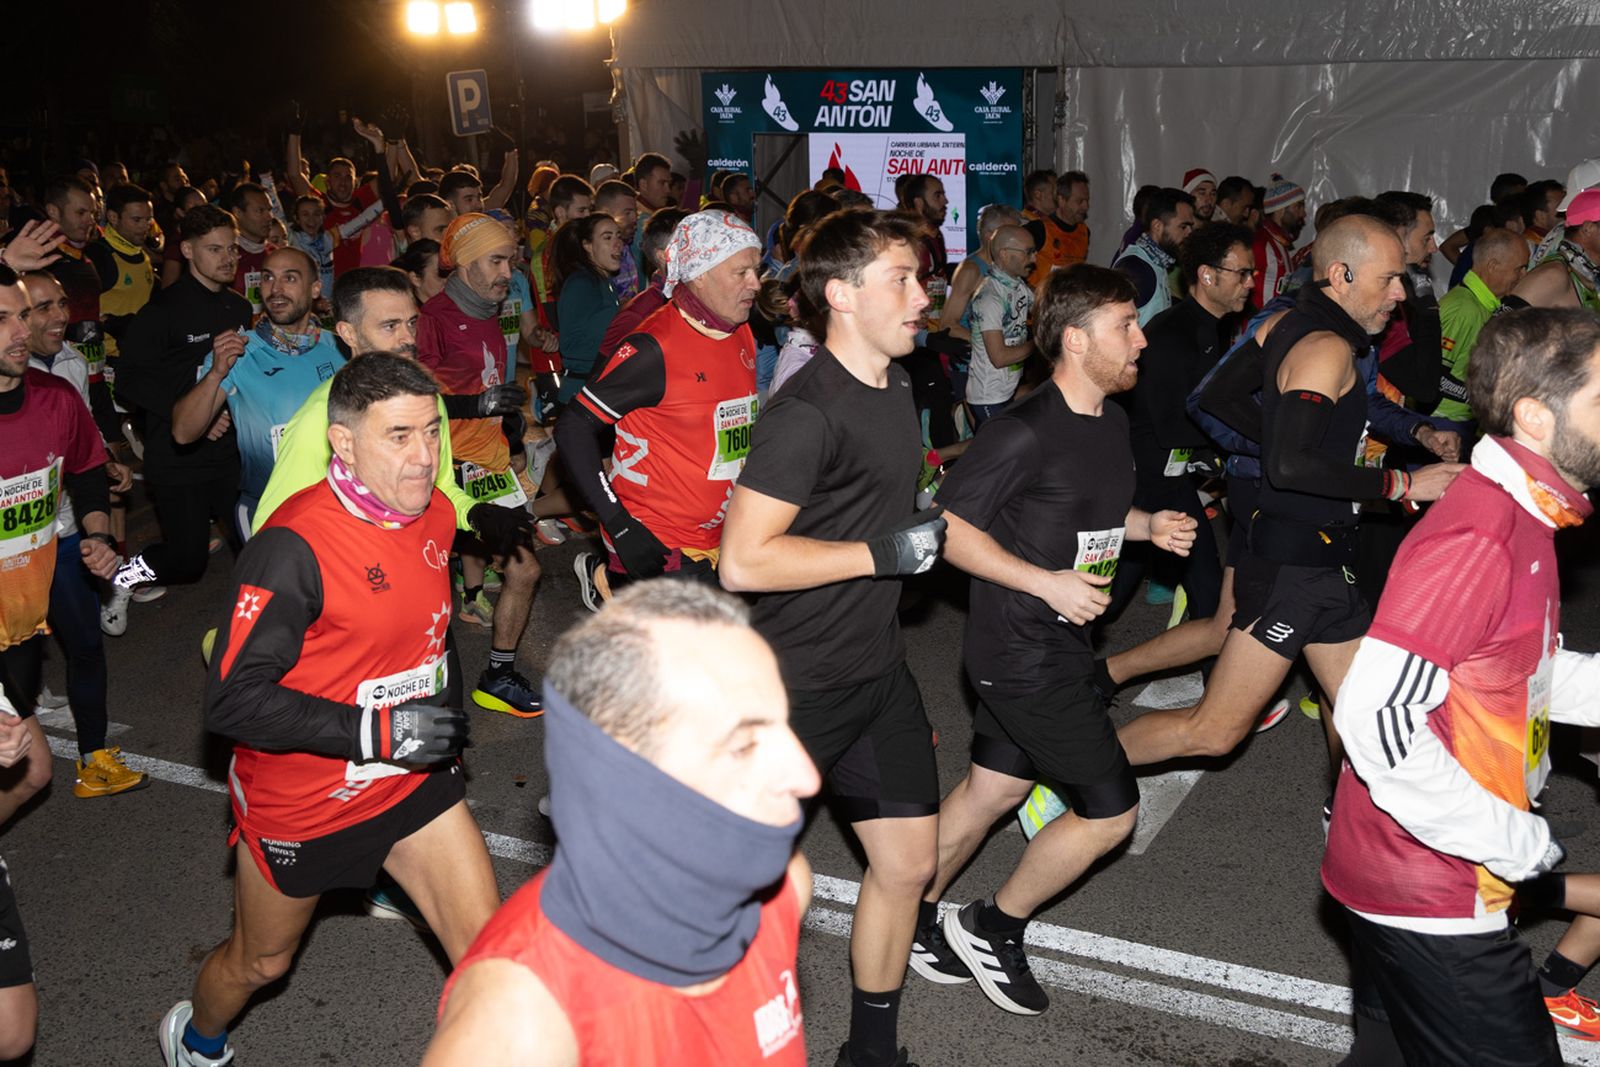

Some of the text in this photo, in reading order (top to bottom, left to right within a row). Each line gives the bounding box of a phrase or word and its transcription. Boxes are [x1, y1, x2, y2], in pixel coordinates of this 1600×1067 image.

[457, 78, 481, 128] P
[772, 105, 787, 122] 43
[813, 99, 893, 127] ANTÓN
[925, 105, 940, 122] 43
[889, 149, 925, 158] NOCHE DE
[707, 158, 749, 168] calderón
[887, 158, 924, 175] SAN
[968, 162, 1017, 171] calderón
[4, 479, 43, 497] NOCHE DE
[471, 473, 507, 499] 6246
[0, 499, 12, 508] AN
[3, 492, 54, 532] 8428
[387, 681, 418, 699] NOCHE
[419, 677, 431, 689] DE
